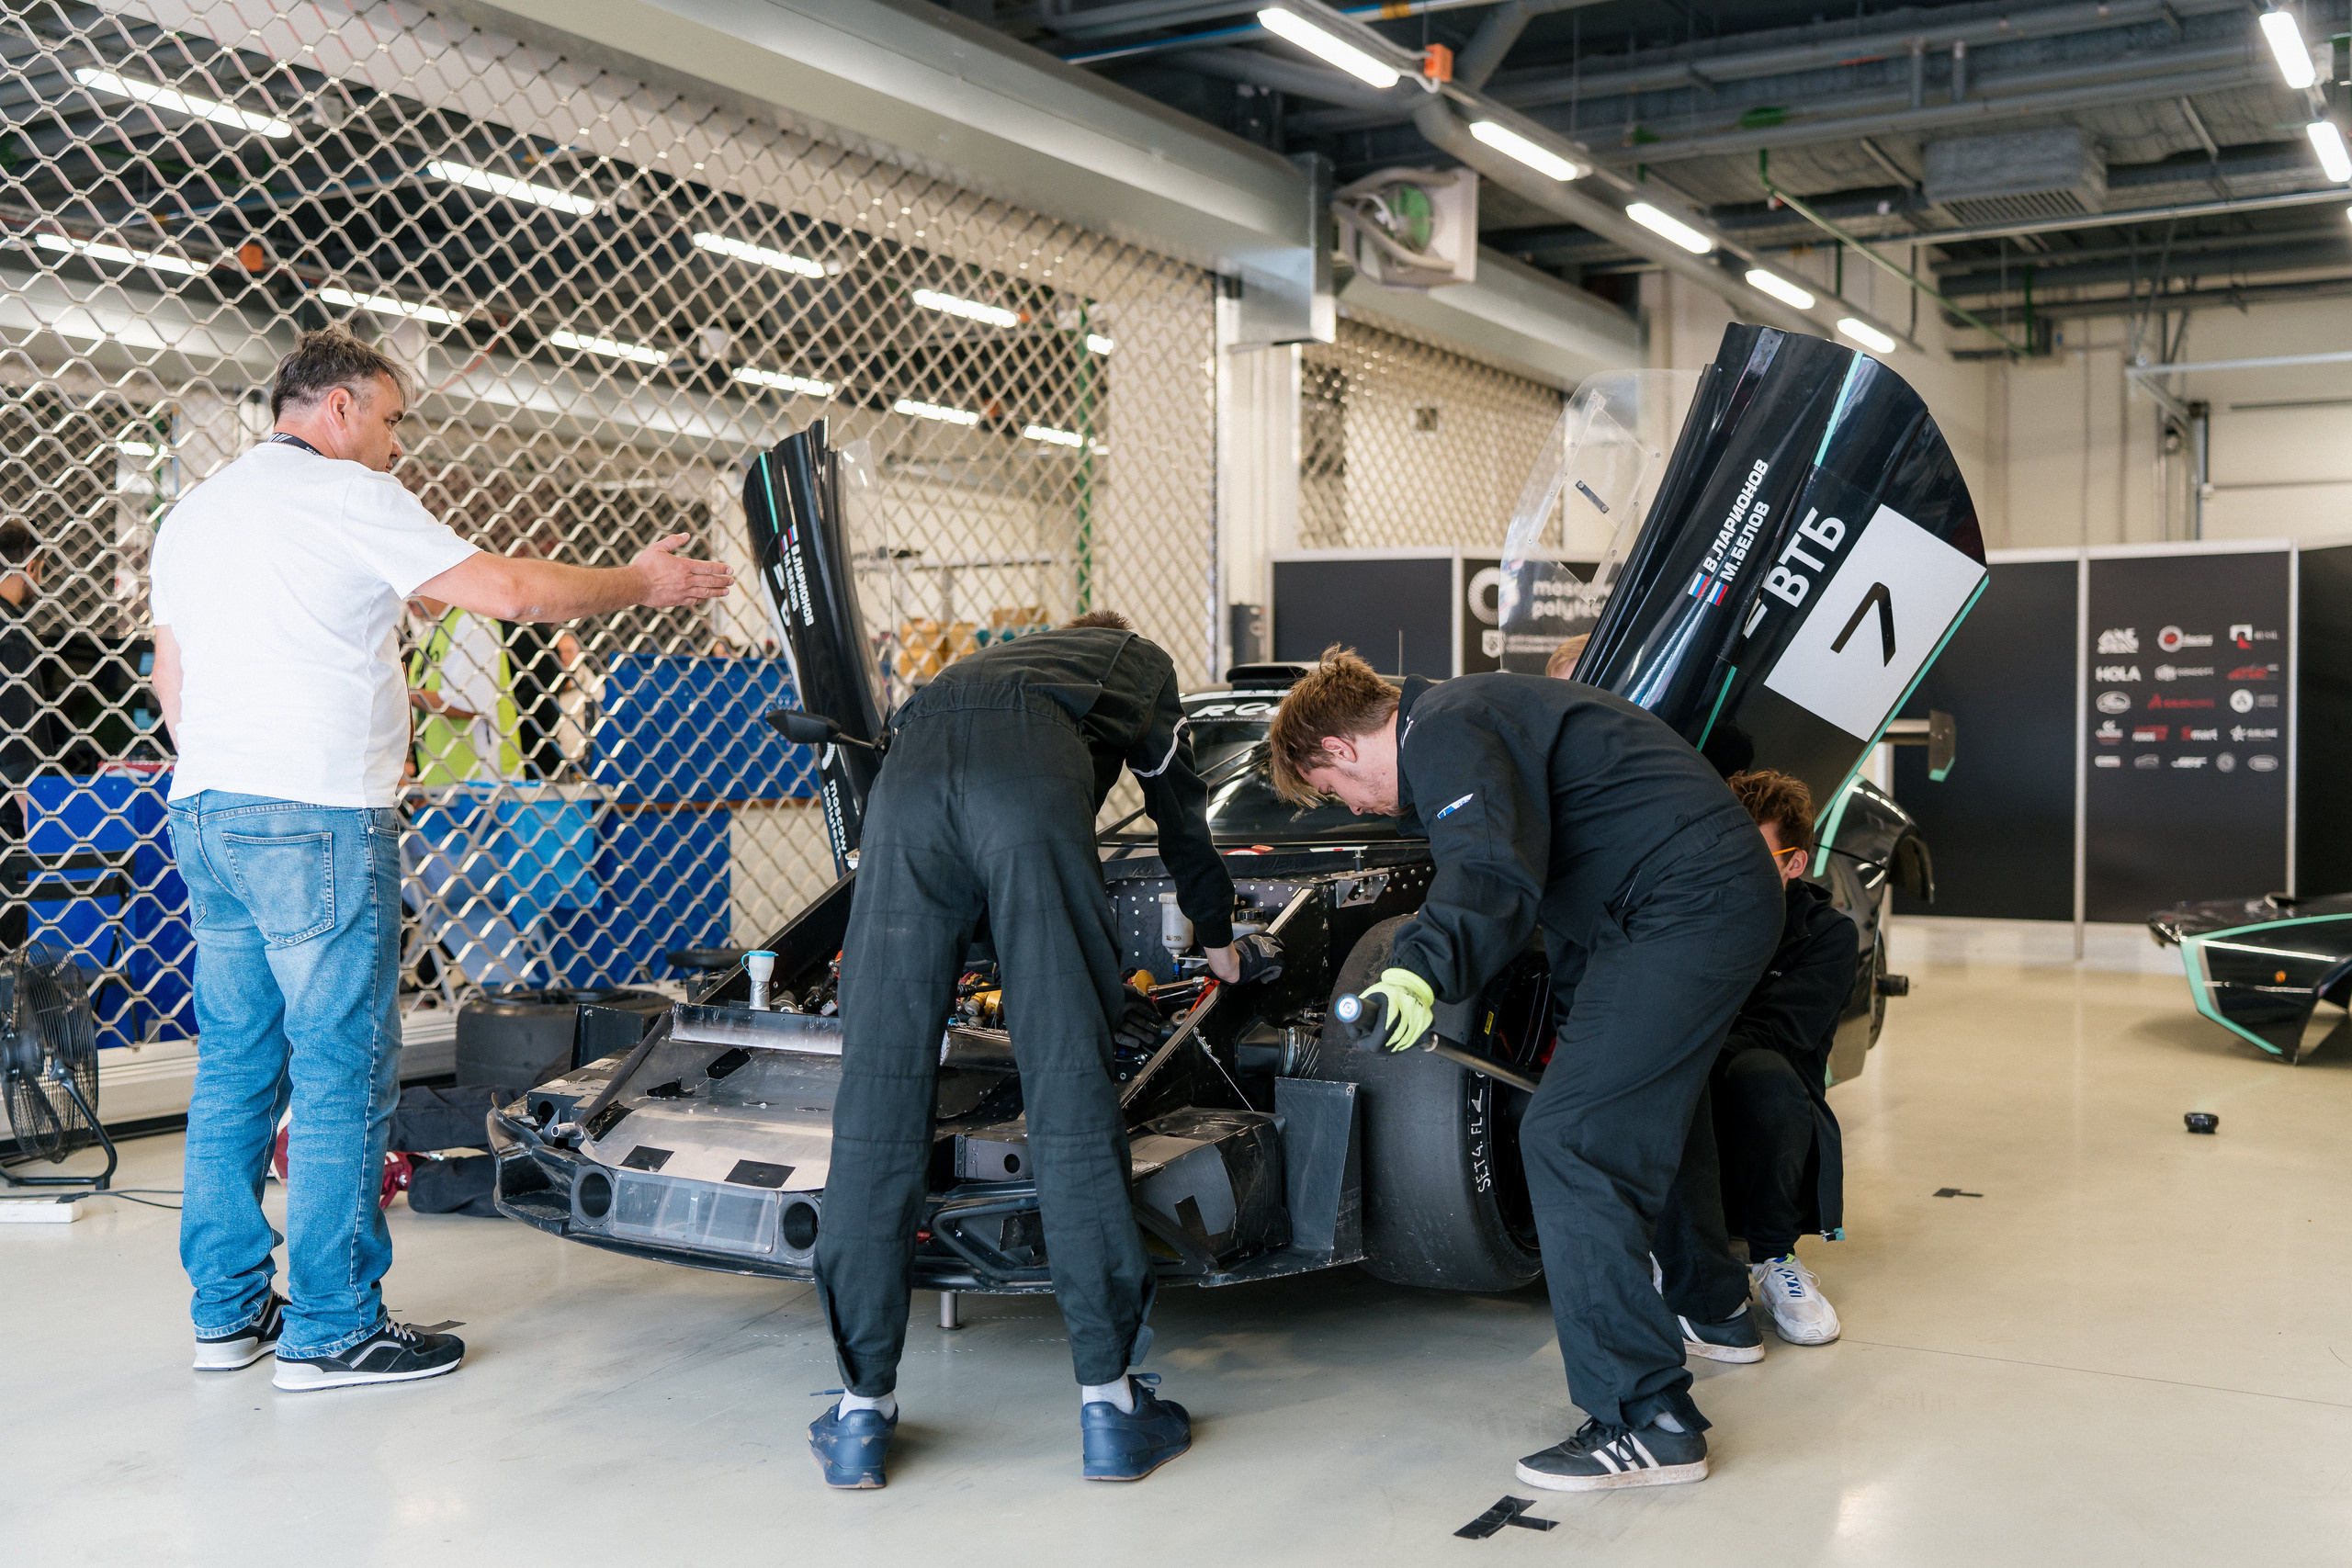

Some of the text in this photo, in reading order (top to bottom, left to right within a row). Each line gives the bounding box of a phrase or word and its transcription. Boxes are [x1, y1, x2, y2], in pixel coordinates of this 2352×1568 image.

[1702, 459, 1769, 573] В.ЛАРИОНОВ
[1719, 502, 1770, 581] М.БЕЛОВ
[1761, 507, 1846, 607] ВТБ
[1830, 581, 1895, 668] 7
[1471, 1117, 1483, 1134] FL
[1474, 1159, 1490, 1192] SET
